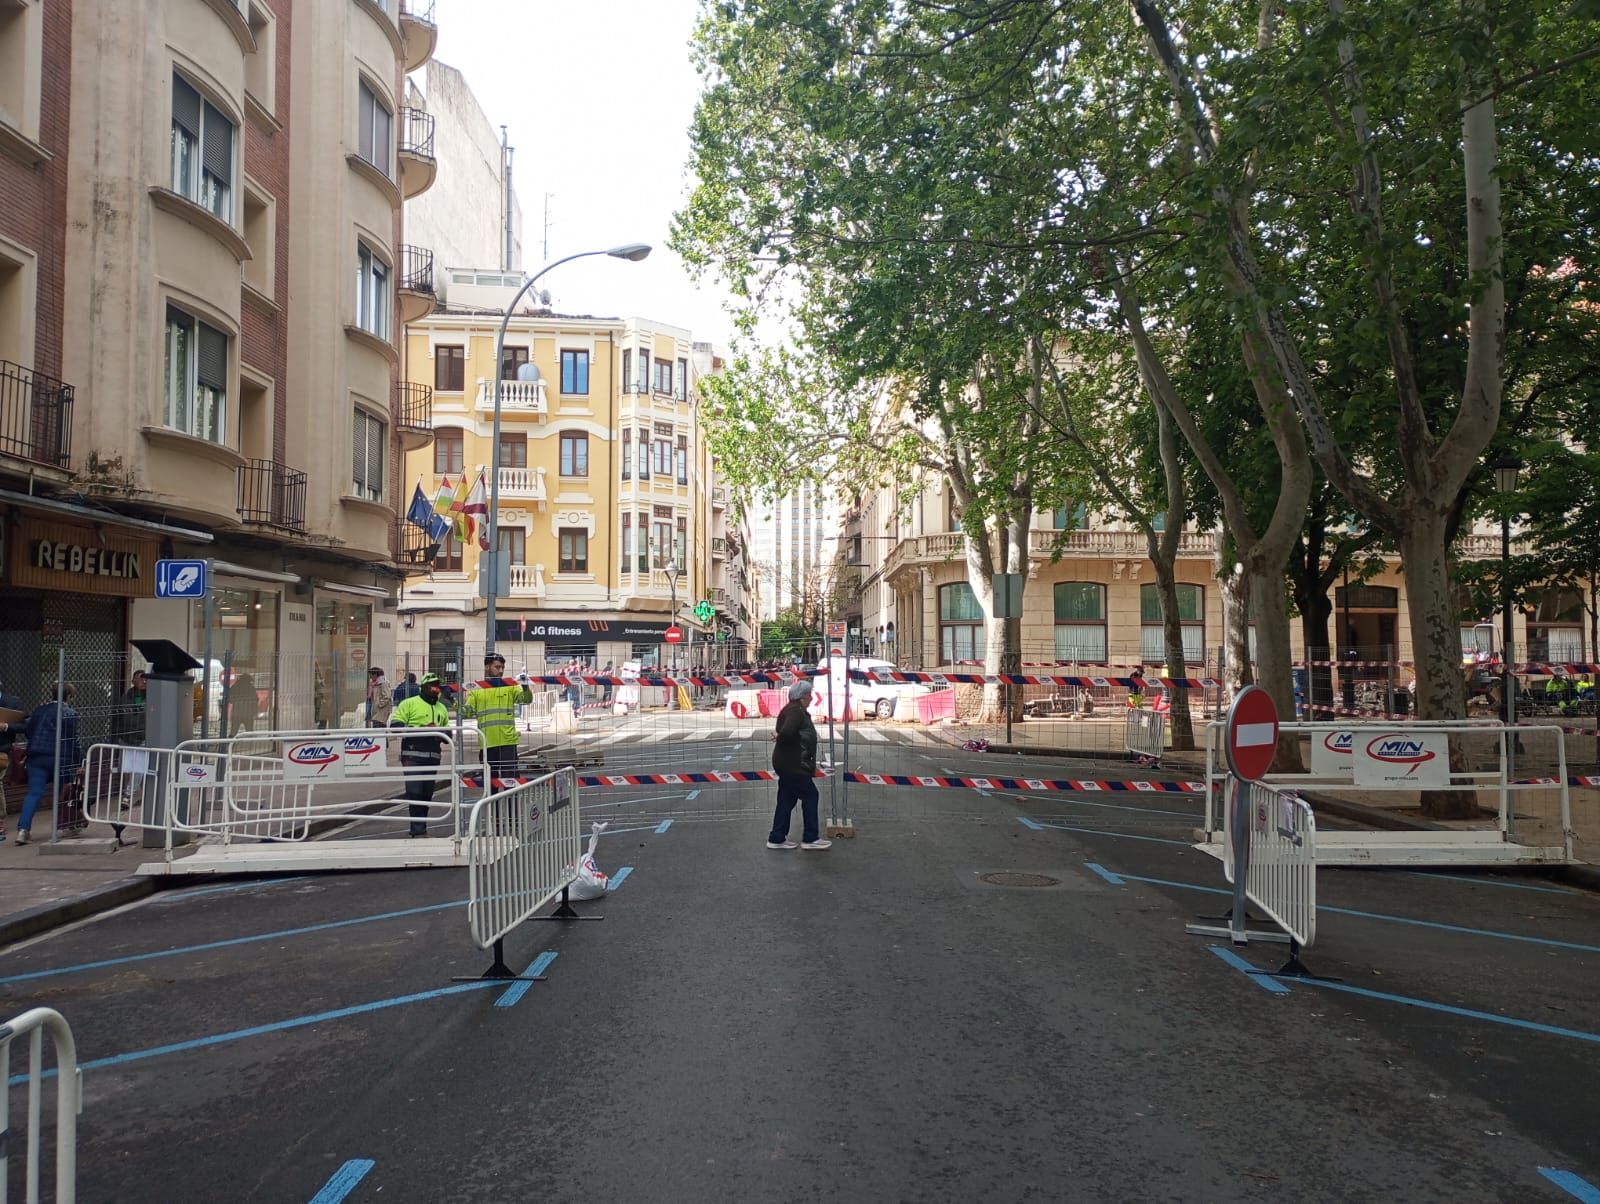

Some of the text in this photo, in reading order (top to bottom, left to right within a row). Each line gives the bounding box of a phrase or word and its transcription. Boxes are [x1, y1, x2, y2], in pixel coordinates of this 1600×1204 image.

[38, 539, 140, 579] REBELLIN
[531, 626, 582, 636] JG fitness
[299, 746, 334, 757] MIN
[1380, 741, 1424, 753] MIN
